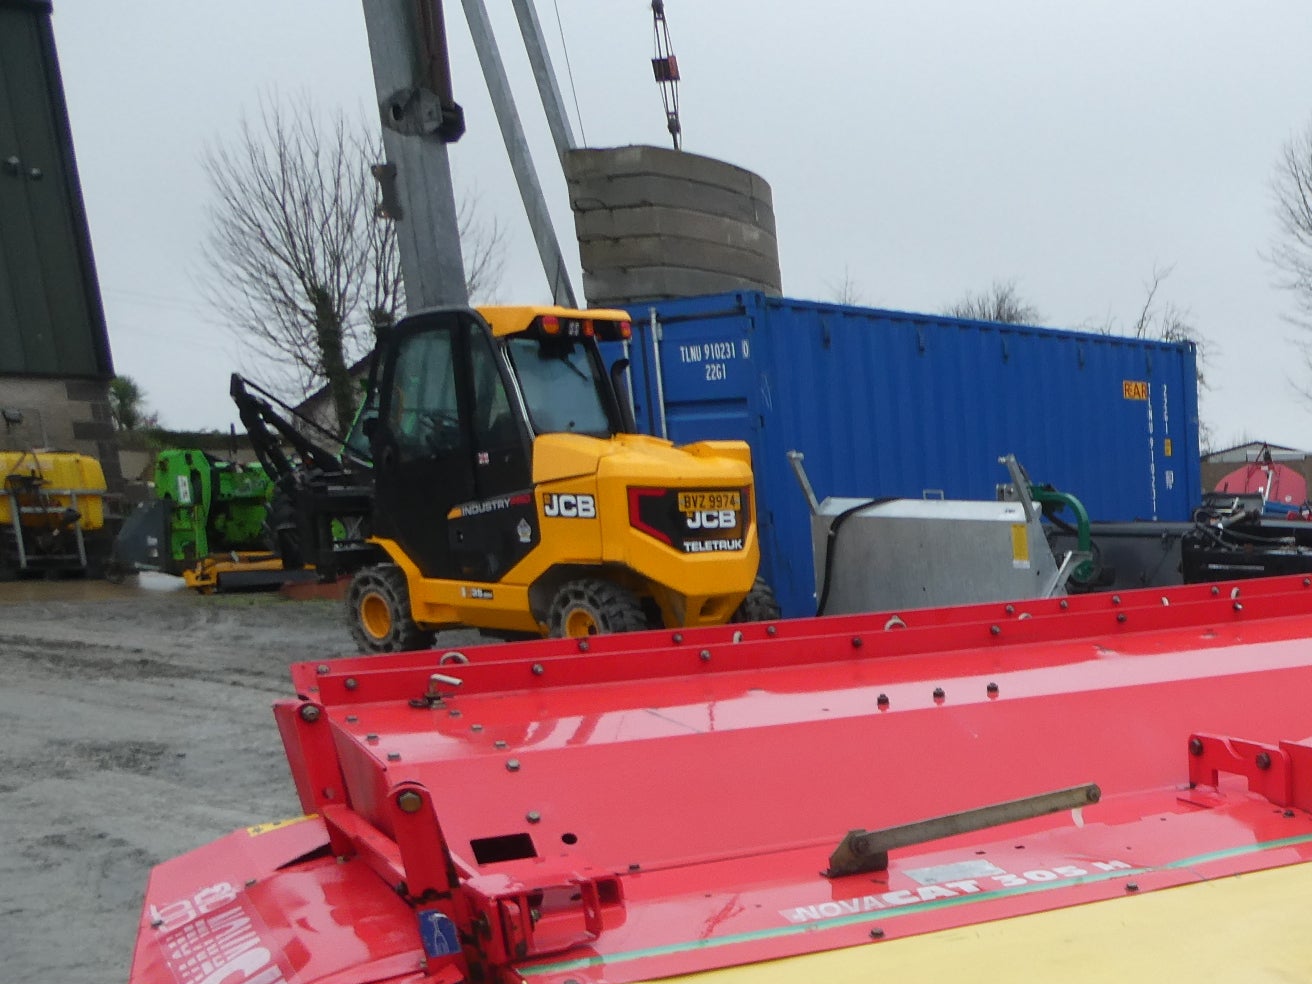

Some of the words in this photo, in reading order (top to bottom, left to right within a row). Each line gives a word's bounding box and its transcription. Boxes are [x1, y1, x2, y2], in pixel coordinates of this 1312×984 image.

[680, 345, 701, 362] TLNU
[704, 342, 735, 360] 910231
[705, 363, 726, 380] 22G1
[462, 498, 510, 516] INDUSTRY
[544, 494, 596, 518] JCB
[684, 496, 705, 508] BVZ
[709, 495, 736, 508] 9974
[687, 509, 737, 529] JCB
[683, 539, 743, 552] TELETRUK
[792, 880, 981, 922] NOVACAT
[991, 865, 1090, 888] 305
